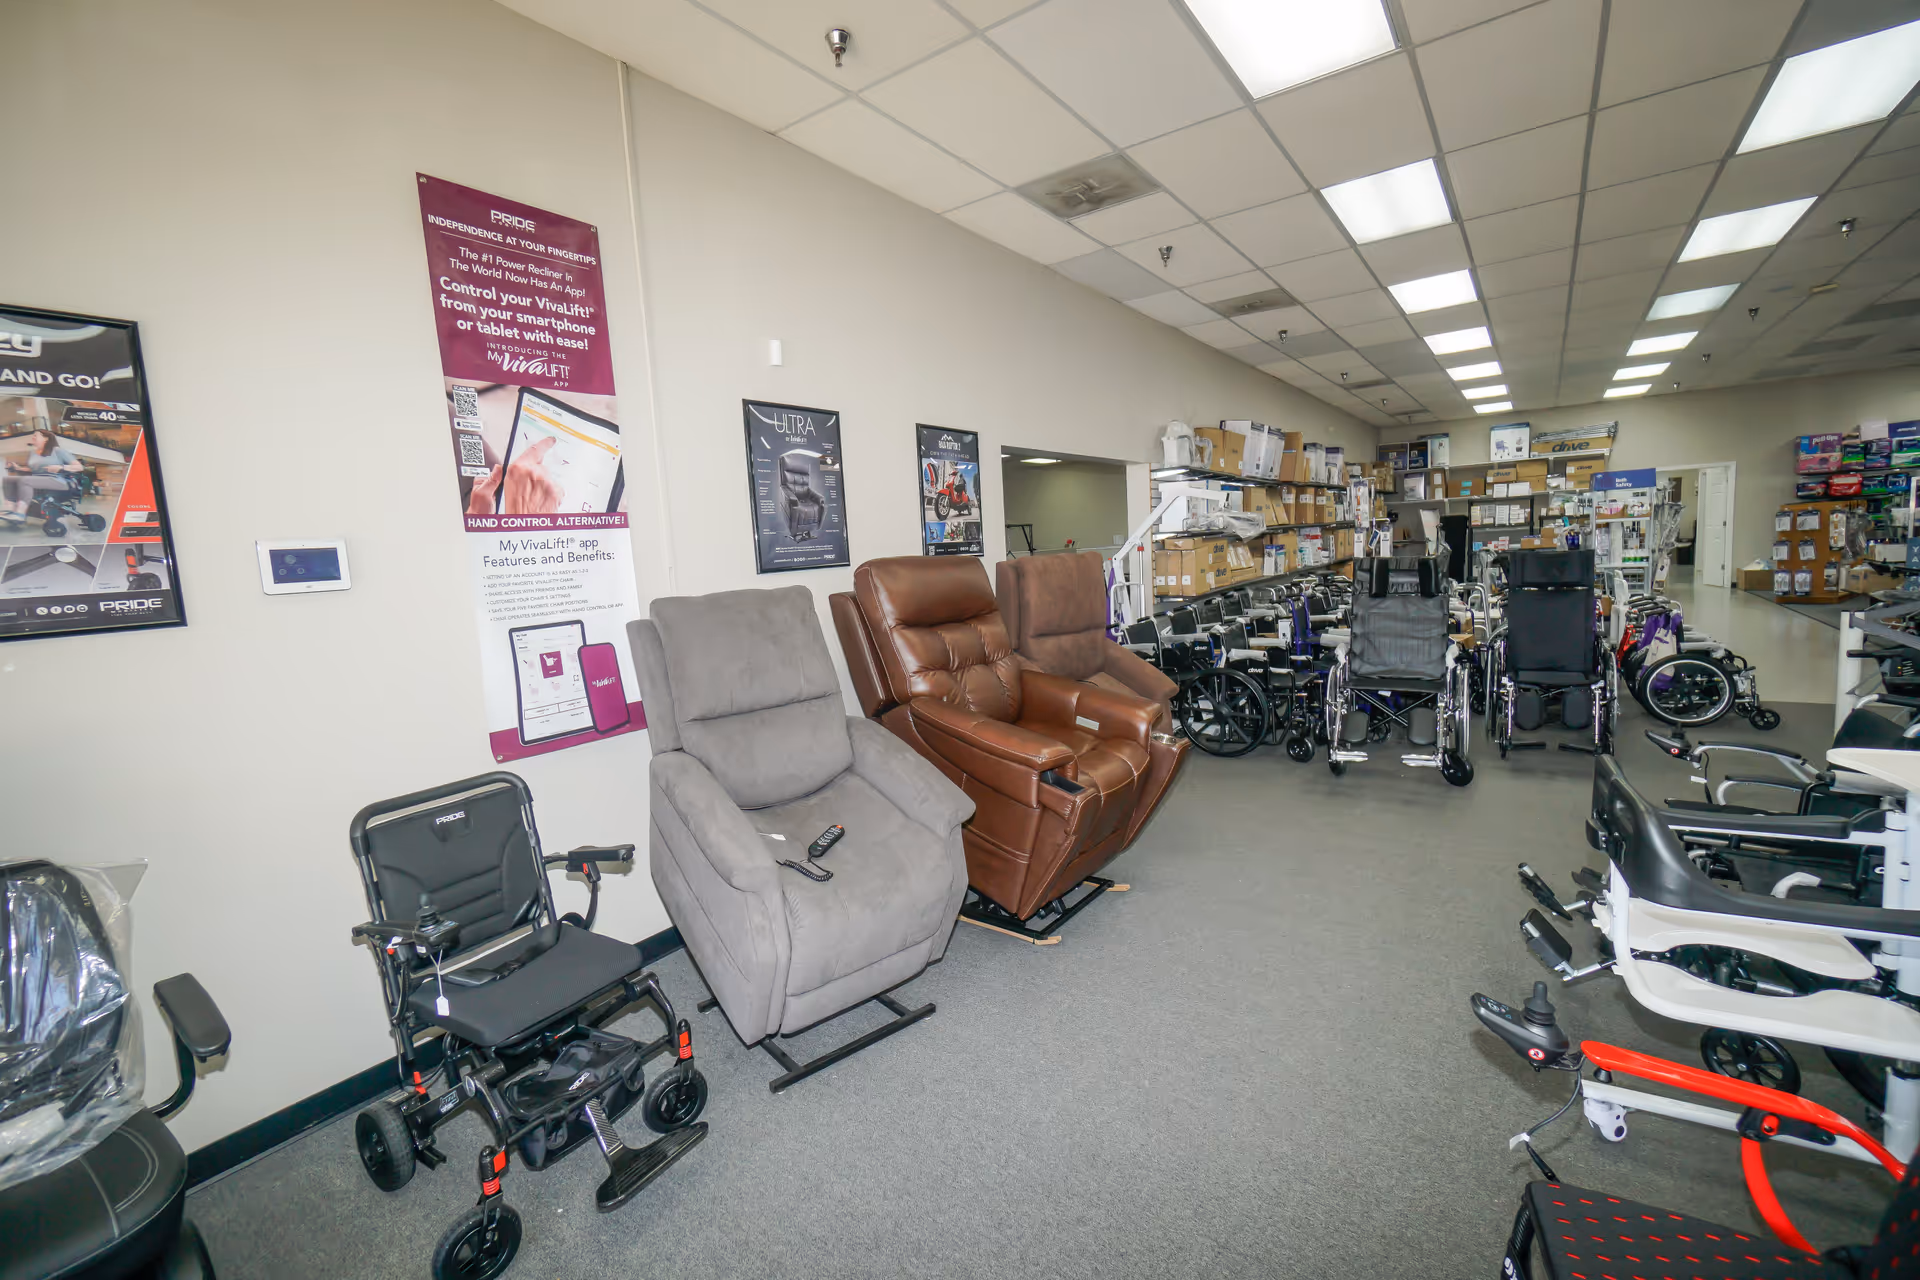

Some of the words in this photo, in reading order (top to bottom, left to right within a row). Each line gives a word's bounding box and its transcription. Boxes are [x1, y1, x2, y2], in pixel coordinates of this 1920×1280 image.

[490, 209, 534, 231] PRIDE
[427, 213, 503, 243] INDEPENDENCE
[505, 235, 517, 246] AT
[519, 238, 546, 253] YOUR
[547, 246, 597, 266] FINGERTIPS
[458, 246, 479, 261] The
[481, 252, 493, 264] #1
[496, 256, 526, 272] Power
[528, 263, 564, 280] Recliner
[565, 271, 573, 283] In
[449, 257, 470, 272] The
[471, 262, 502, 279] World
[505, 271, 529, 286] Now
[530, 277, 548, 289] Has
[550, 282, 563, 293] An
[564, 285, 586, 299] App!
[439, 276, 497, 301] Control
[499, 292, 533, 306] your
[439, 293, 477, 315] from
[479, 305, 514, 320] your
[516, 312, 596, 336] smartphone
[456, 318, 474, 331] or
[476, 320, 521, 340] tablet
[522, 329, 554, 345] with
[556, 336, 589, 350] ease!
[486, 342, 549, 357] INTRODUCING
[551, 351, 567, 360] THE
[0, 368, 53, 386] AND
[57, 373, 101, 389] GO!
[553, 380, 569, 388] APP
[98, 411, 117, 421] 40
[774, 412, 816, 436] ULTRA
[1552, 441, 1590, 452] drive
[467, 518, 498, 528] HAND
[500, 517, 554, 528] CONTROL
[555, 515, 625, 527] ALTERNATIVE!
[499, 540, 519, 555] My
[579, 538, 599, 551] app
[1213, 543, 1225, 554] drive
[483, 554, 537, 568] Features
[541, 552, 564, 565] and
[567, 550, 616, 563] Benefits:
[1215, 567, 1227, 578] drive
[99, 598, 164, 612] PRIDE
[435, 810, 466, 825] PRIDE
